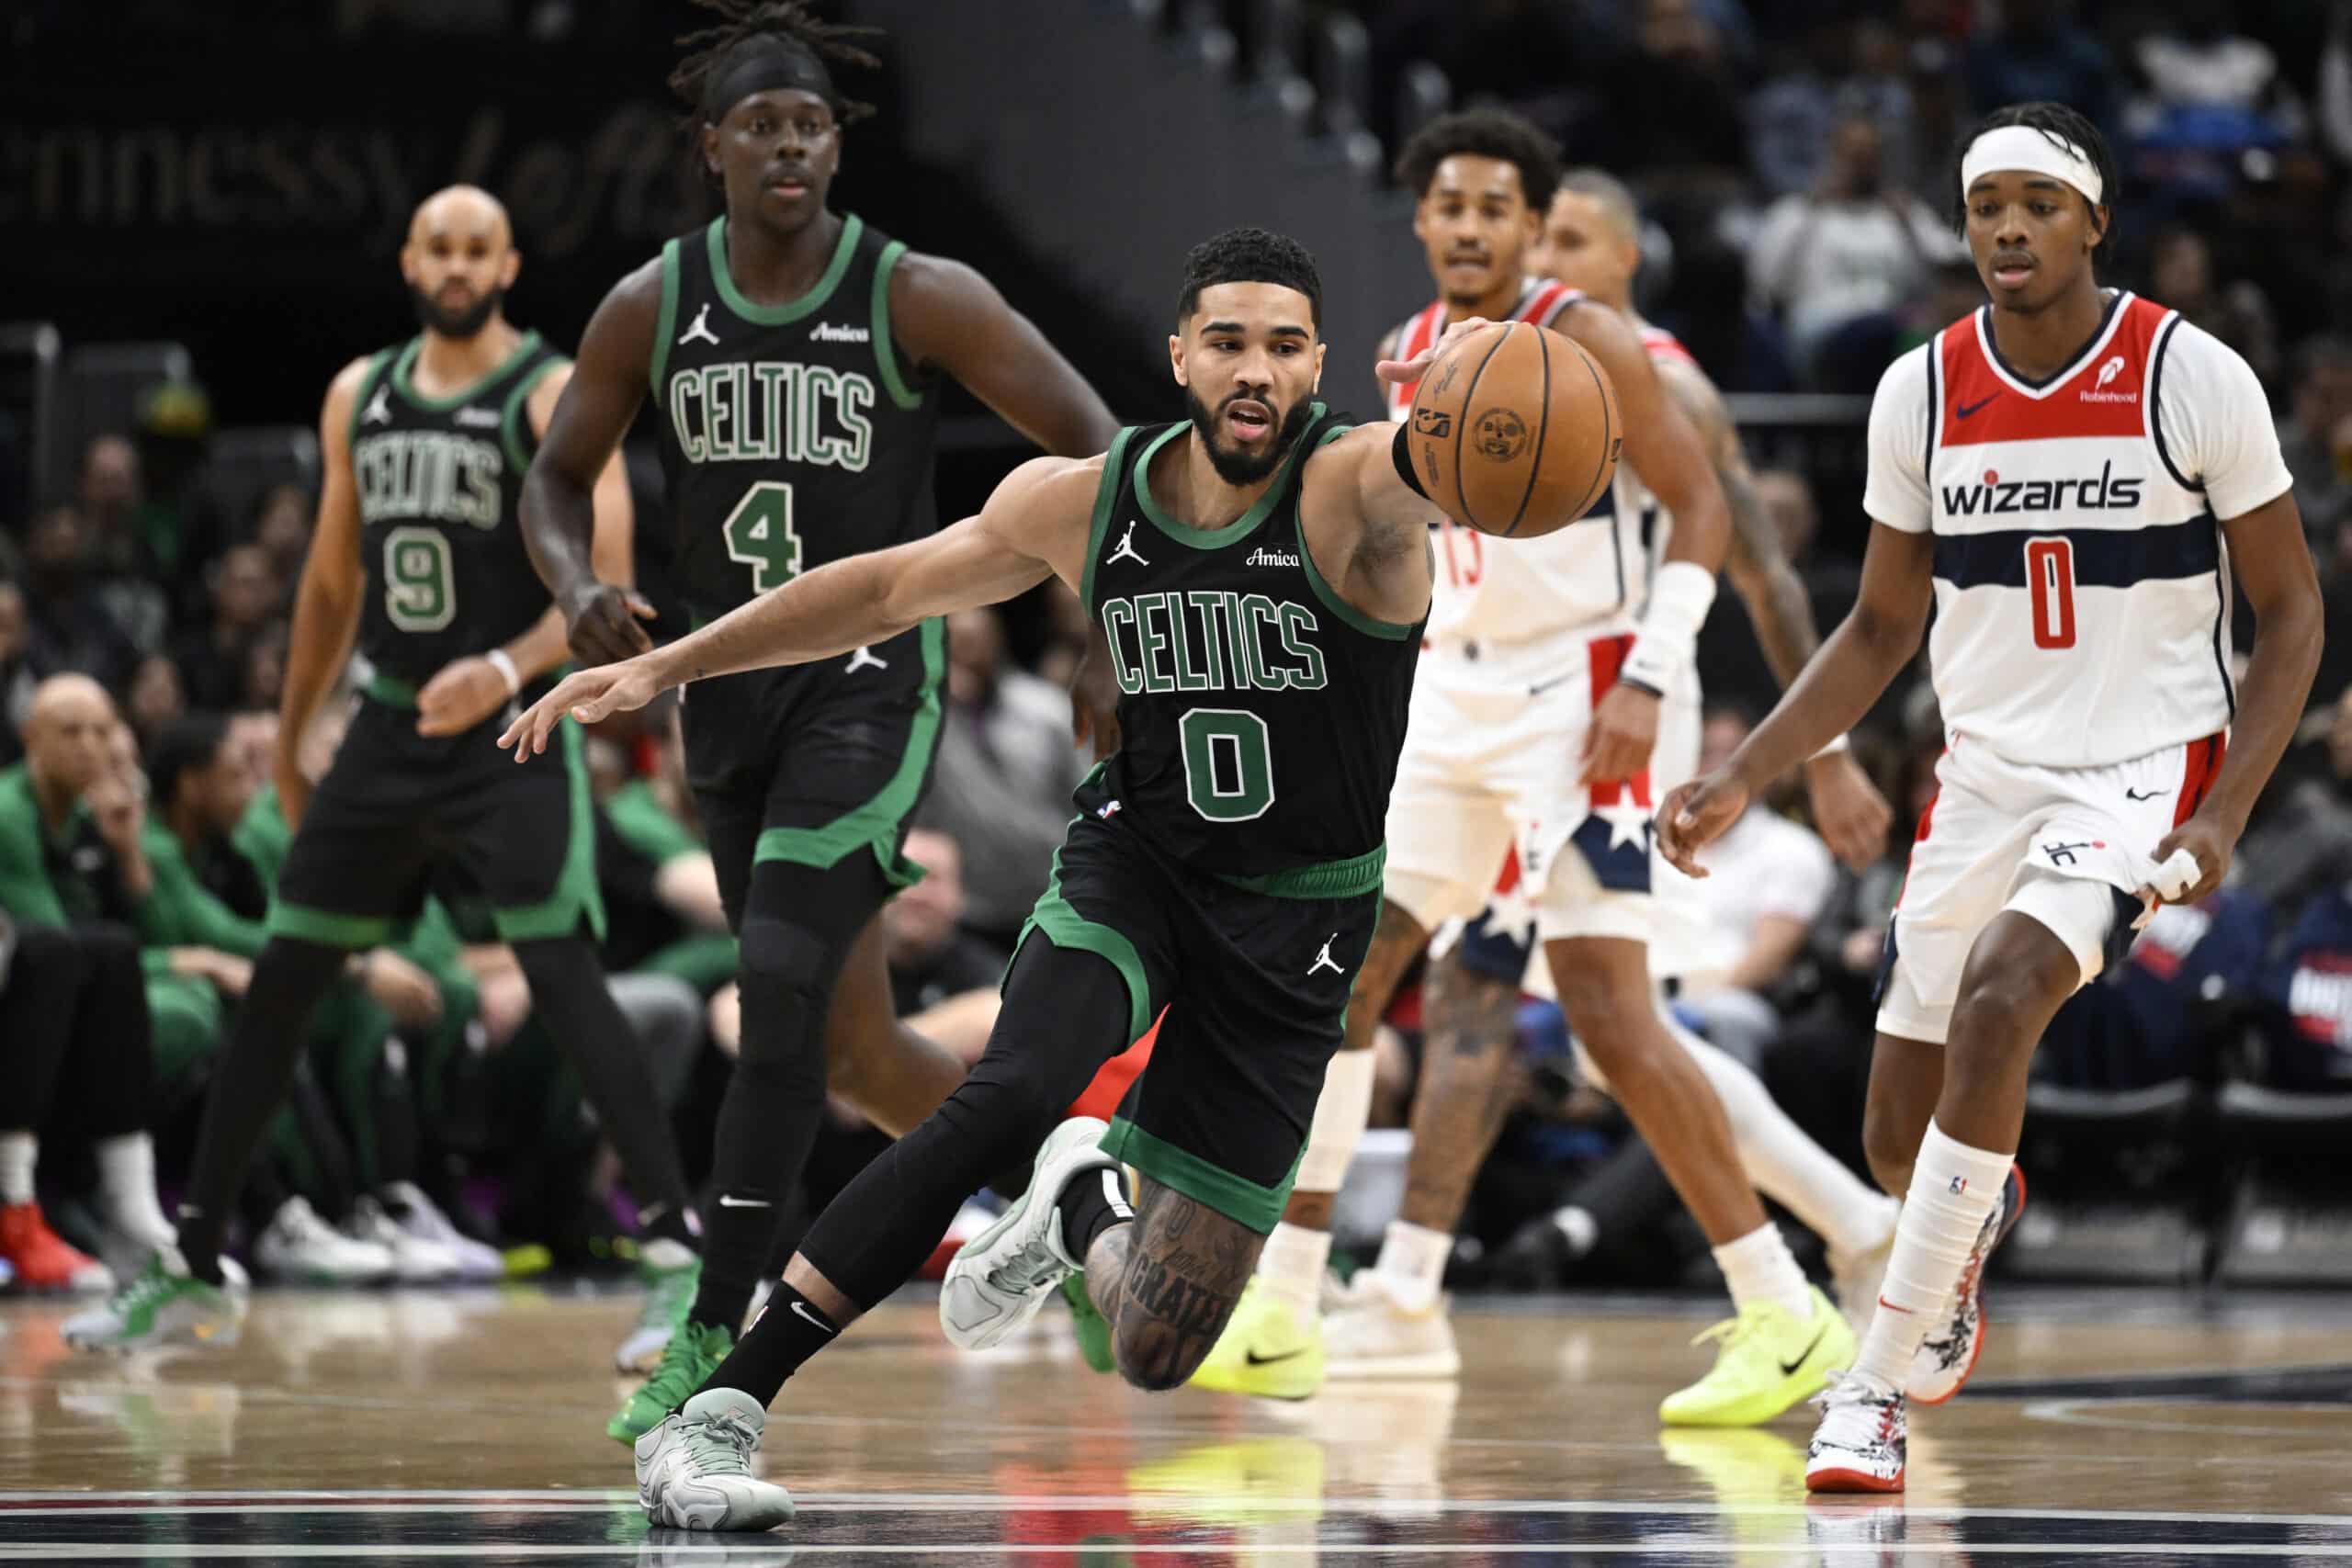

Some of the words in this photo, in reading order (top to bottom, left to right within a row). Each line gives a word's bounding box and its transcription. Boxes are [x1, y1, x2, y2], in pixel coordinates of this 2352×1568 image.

[809, 321, 869, 343] Amica
[670, 361, 875, 472] CELTICS
[2080, 389, 2137, 403] Robinhood
[354, 430, 503, 530] CELTICS
[1942, 458, 2145, 516] wizards
[383, 525, 457, 632] 9
[723, 480, 802, 595] 4
[1246, 547, 1300, 567] Amica
[1102, 591, 1328, 694] CELTICS
[2024, 536, 2076, 649] 0
[1179, 708, 1275, 822] 0
